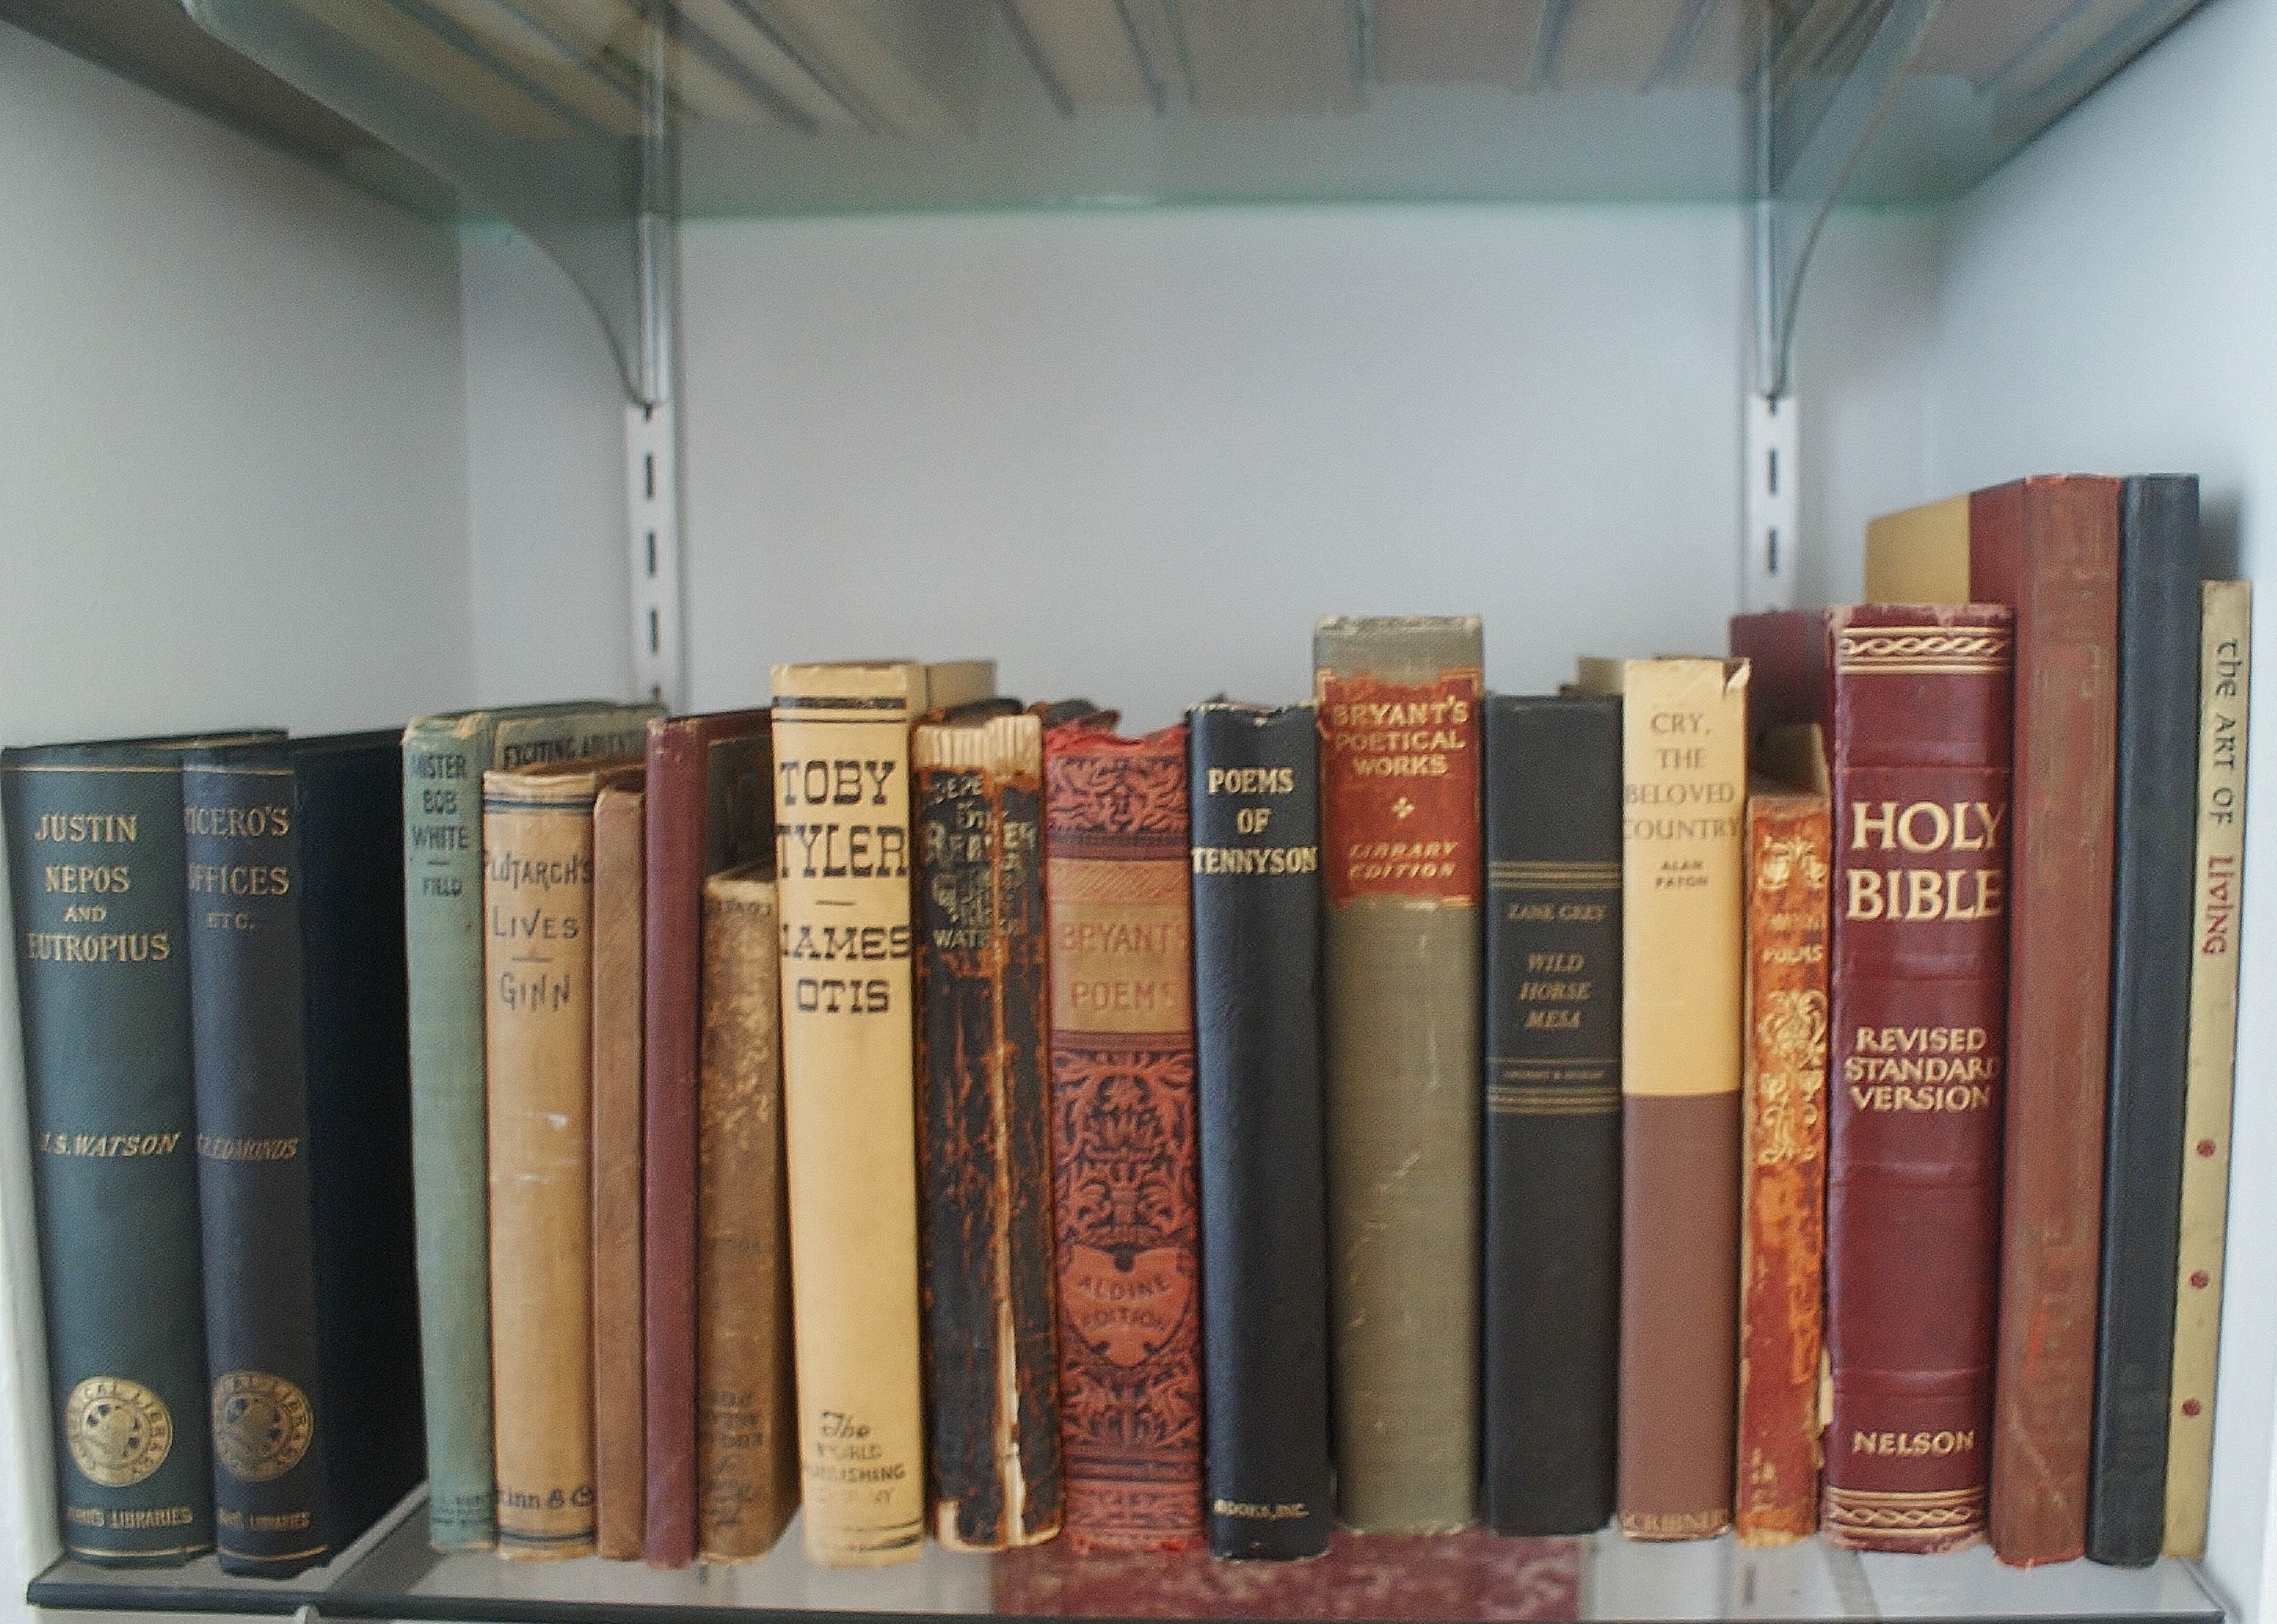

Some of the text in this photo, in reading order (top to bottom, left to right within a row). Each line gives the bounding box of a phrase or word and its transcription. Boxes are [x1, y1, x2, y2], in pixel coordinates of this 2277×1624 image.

[1332, 696, 1469, 726] BRYANT'S
[1650, 712, 1711, 735] CRY,
[1335, 729, 1466, 751] POETICAL
[2212, 715, 2237, 769] ART
[1353, 754, 1448, 777] WORKS
[1656, 748, 1705, 770] THE
[779, 760, 896, 806] TOBY
[1208, 767, 1295, 795] POEMS
[1625, 784, 1736, 805] BELOVED
[423, 789, 457, 815] BOB
[2209, 787, 2234, 827] OF
[34, 814, 137, 842] JUSTIN
[184, 805, 290, 837] ICERO'S
[1236, 808, 1273, 835] OF
[1625, 818, 1740, 841] COUNTRY
[1850, 801, 2006, 853] HOLY
[411, 826, 470, 851] WHITE
[777, 825, 909, 879] TYLER
[1348, 840, 1459, 860] LIBRARY
[1193, 846, 1319, 875] TENNYSON
[1348, 862, 1455, 880] EDITION
[44, 864, 131, 893] NEPOS
[1846, 868, 2003, 921] BIBLE
[61, 904, 107, 922] AND
[492, 905, 579, 940] LIVES
[28, 931, 170, 962] EUTROPIUS
[1528, 952, 1585, 973] WILD
[499, 971, 570, 1012] GINN
[798, 979, 889, 1013] OTIS
[1519, 980, 1592, 1001] HORSE
[1526, 1008, 1582, 1029] MESA
[1855, 1026, 1987, 1055] REVISED
[1849, 1085, 1991, 1113] VERSION
[820, 1411, 871, 1439] The
[1852, 1430, 1974, 1456] NELSON
[498, 1487, 540, 1510] inn
